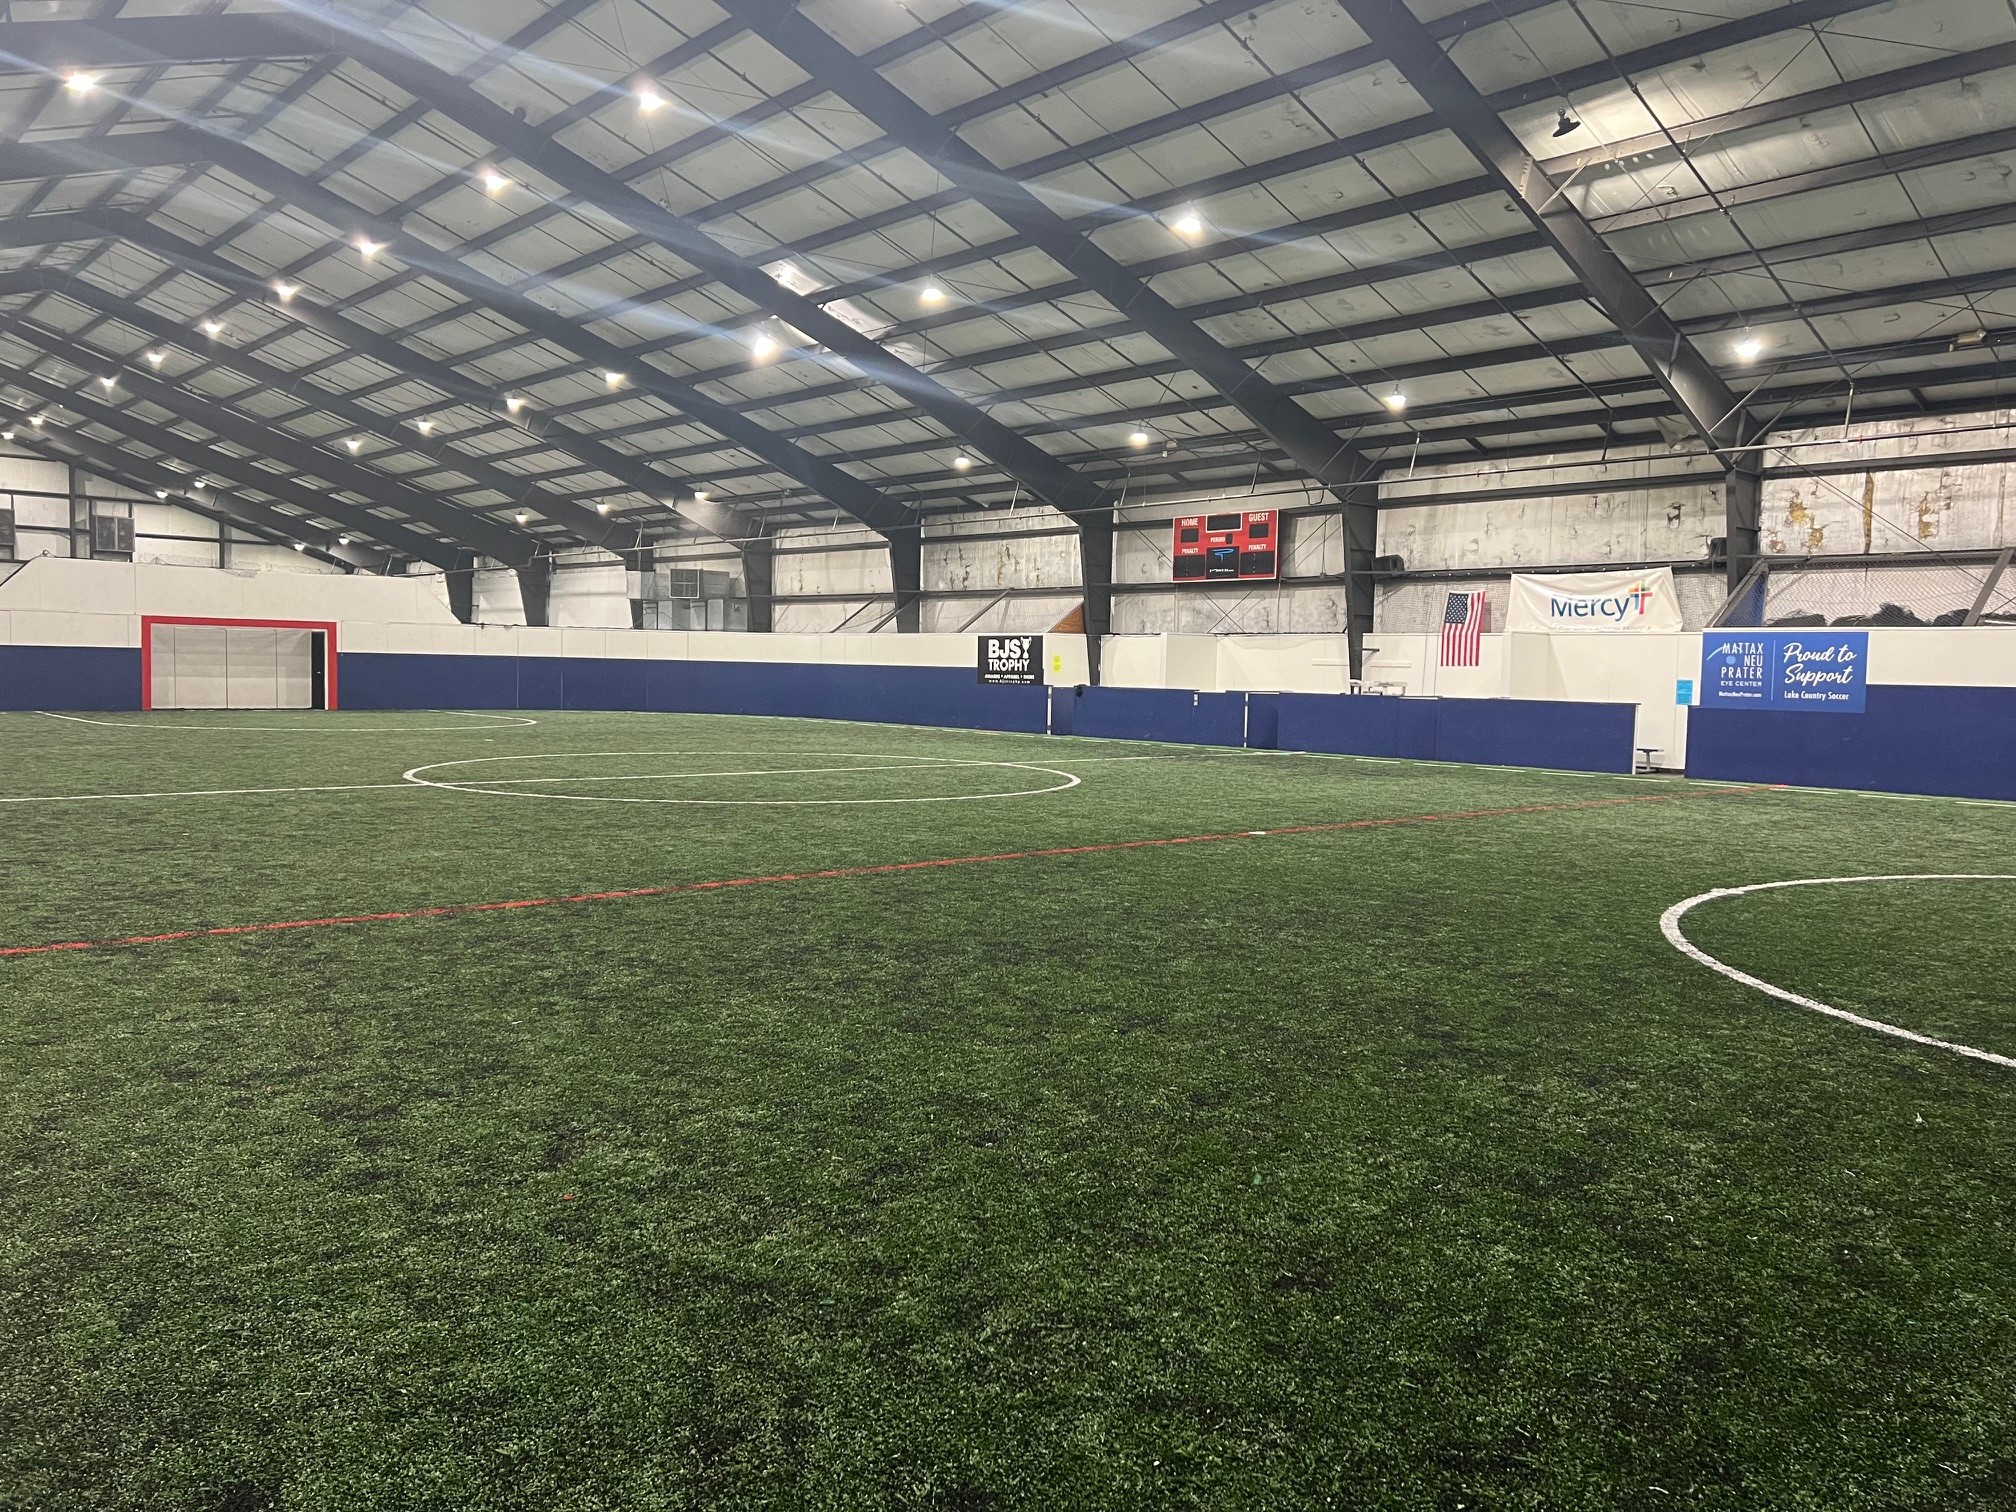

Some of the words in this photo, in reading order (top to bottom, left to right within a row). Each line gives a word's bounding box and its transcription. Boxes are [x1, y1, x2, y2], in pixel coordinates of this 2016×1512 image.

[1181, 518, 1199, 526] HOME
[1248, 513, 1269, 522] GUEST
[1248, 543, 1267, 551] PENALTY
[1551, 596, 1631, 622] Mercy
[988, 639, 1021, 658] BJS
[1721, 642, 1764, 654] MATTAX
[1783, 642, 1835, 663] Proud
[1837, 644, 1858, 663] to
[988, 659, 1030, 671] TROPHY
[1743, 655, 1763, 667] NEU
[1721, 667, 1763, 679] PRATER
[1784, 663, 1854, 687] Support
[1784, 690, 1799, 699] Lake
[1800, 690, 1827, 702] Country
[1828, 691, 1849, 700] Soccer
